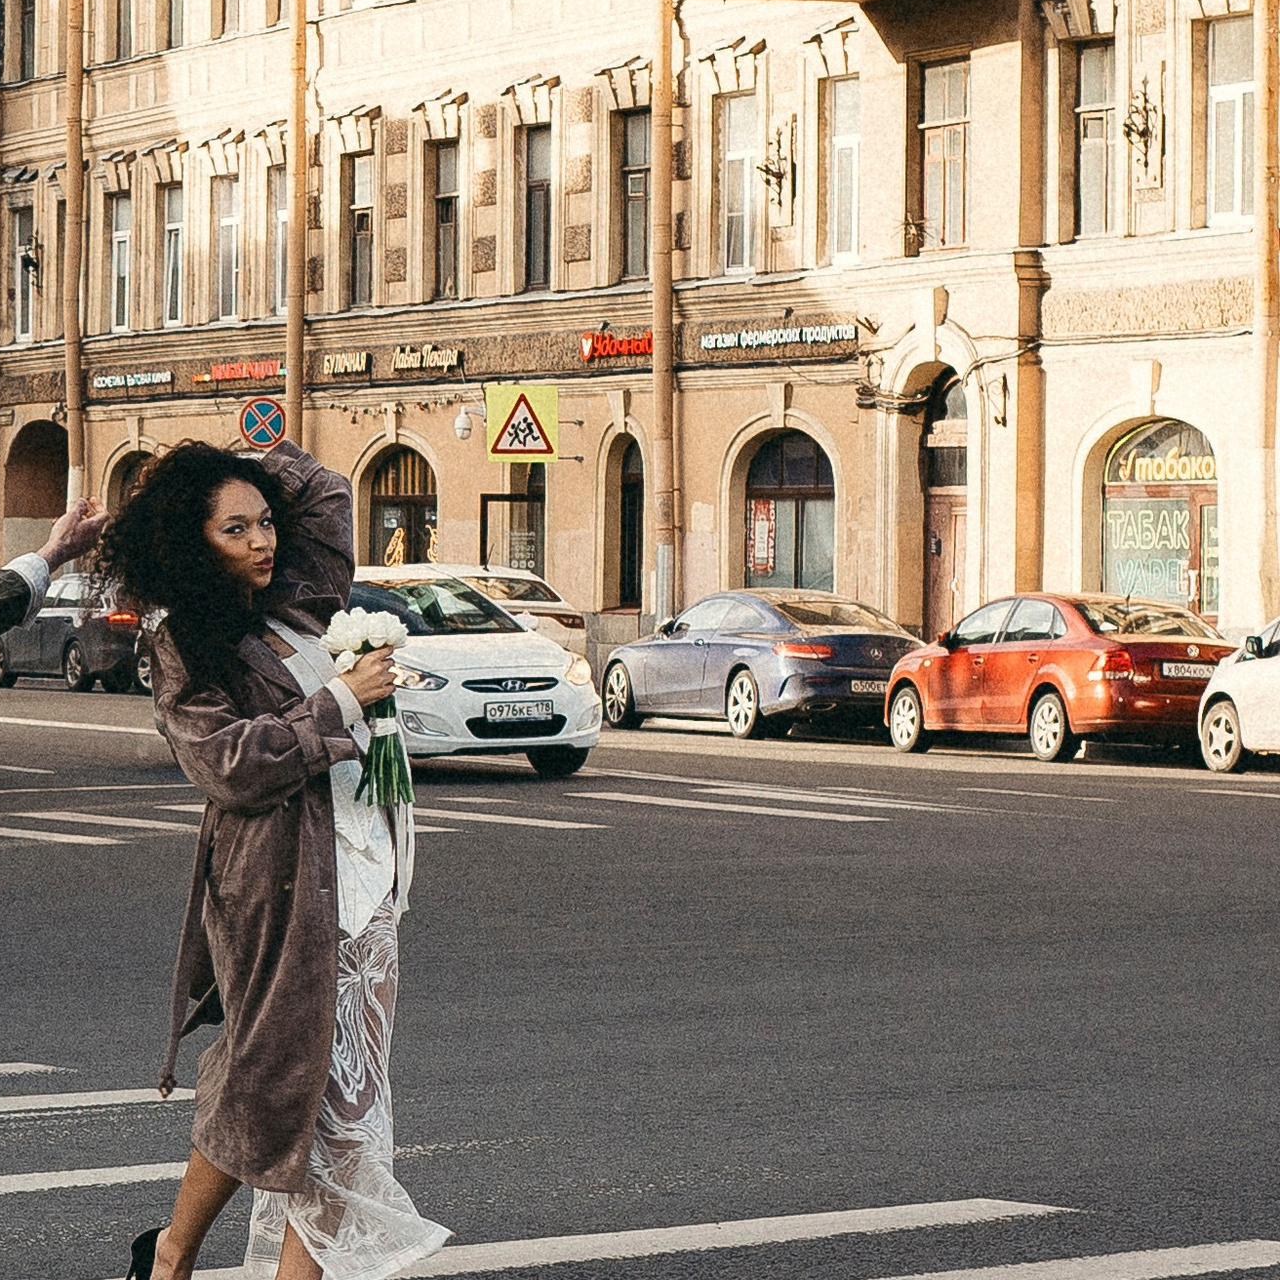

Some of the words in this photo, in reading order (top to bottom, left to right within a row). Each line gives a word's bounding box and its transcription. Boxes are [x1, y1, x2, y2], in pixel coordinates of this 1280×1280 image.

[701, 333, 738, 350] магазин
[739, 328, 801, 349] фермерских
[802, 325, 856, 344] продуктов
[323, 352, 367, 375] БУЛОЧНАЯ
[1107, 509, 1190, 550] ТАБАК
[489, 704, 533, 718] О976КЕ
[534, 702, 551, 713] 178
